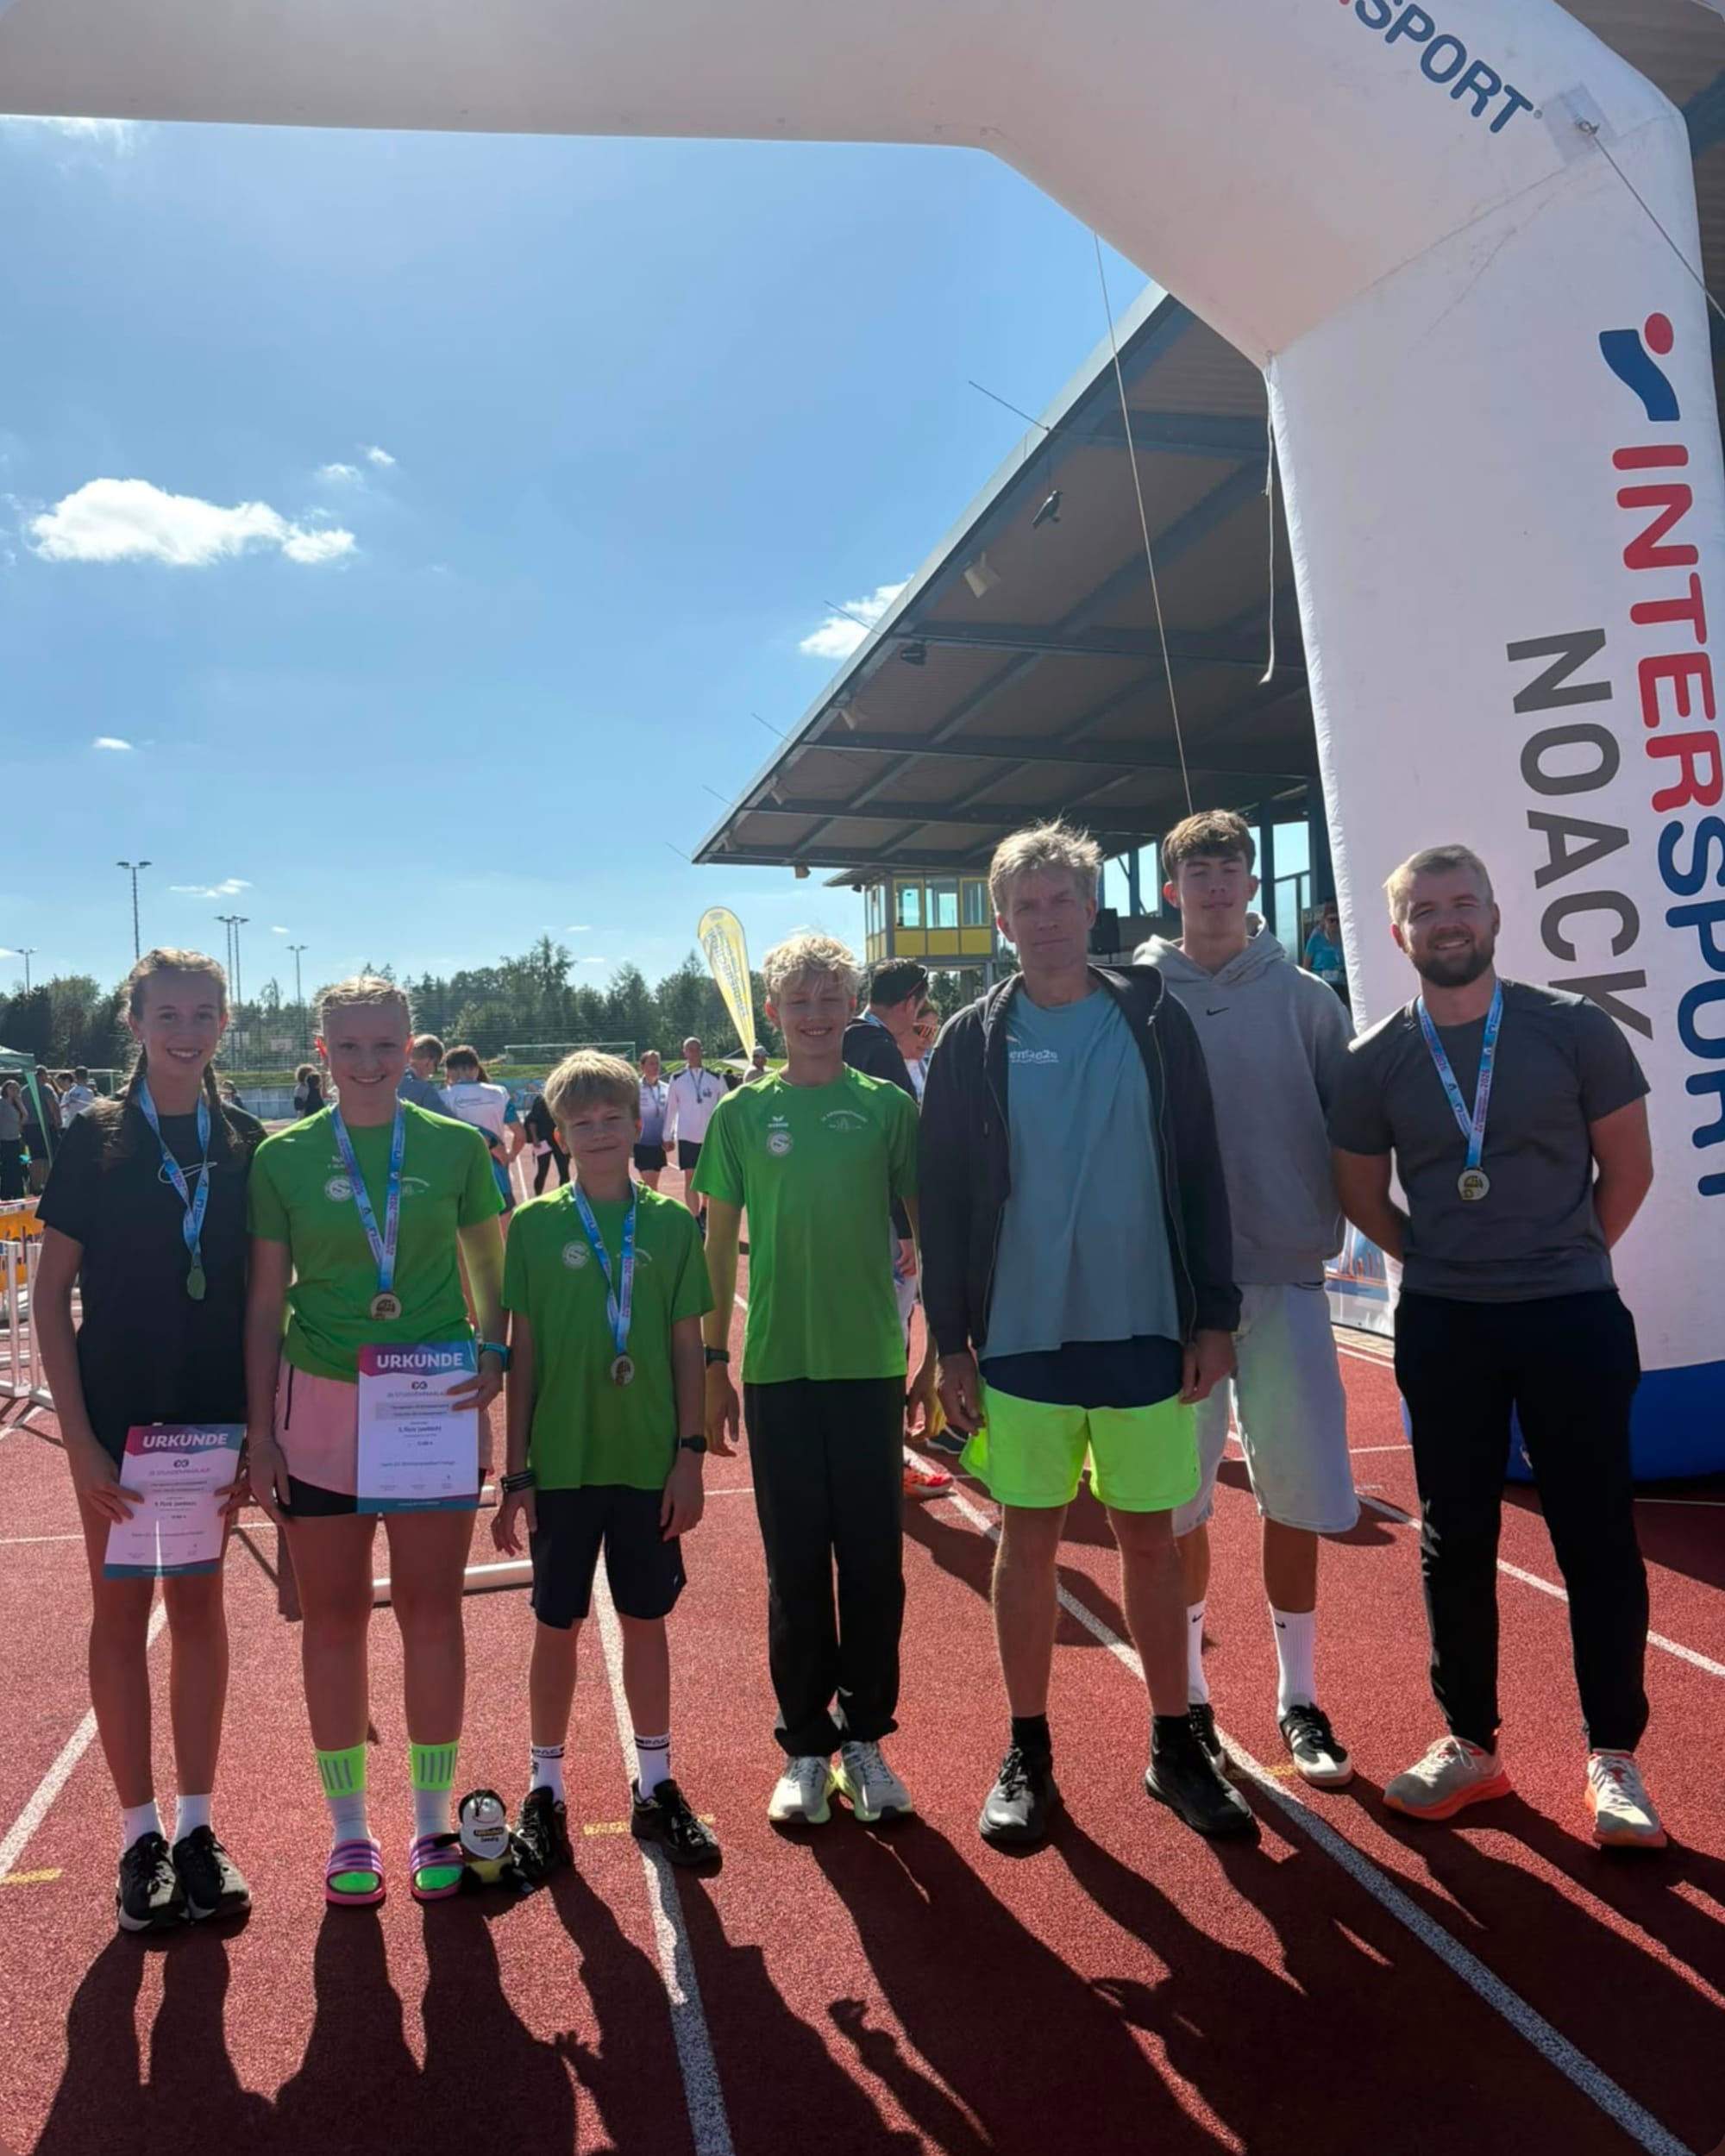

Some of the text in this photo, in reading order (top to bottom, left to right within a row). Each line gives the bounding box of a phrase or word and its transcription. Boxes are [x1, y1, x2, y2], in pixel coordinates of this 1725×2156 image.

[1339, 0, 1534, 133] SPORT
[1506, 628, 1653, 1041] NOACK
[377, 1352, 463, 1368] URKUNDE
[142, 1433, 228, 1448] URKUNDE
